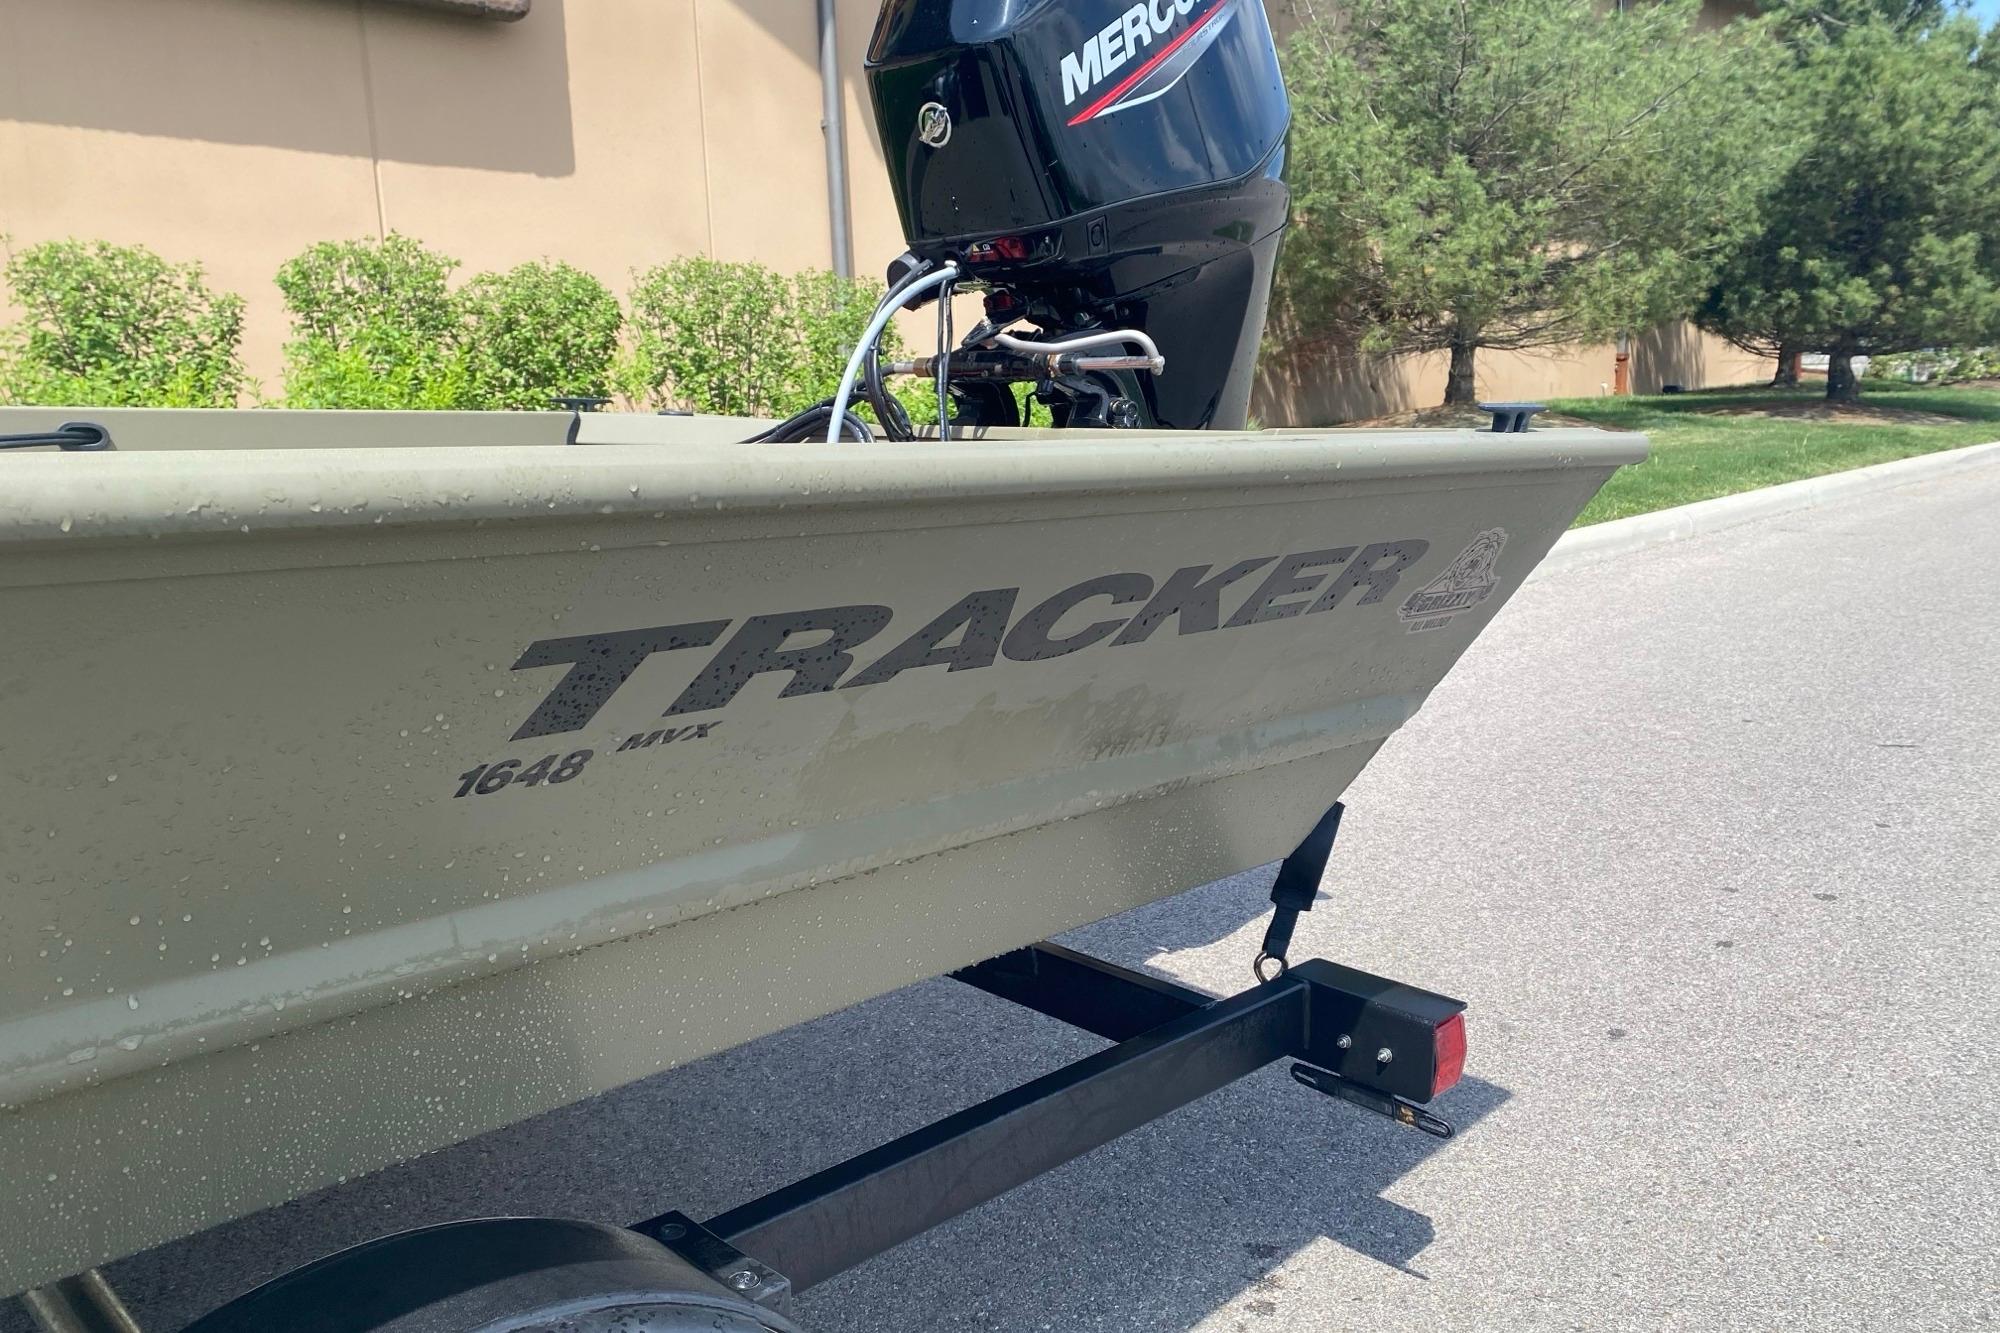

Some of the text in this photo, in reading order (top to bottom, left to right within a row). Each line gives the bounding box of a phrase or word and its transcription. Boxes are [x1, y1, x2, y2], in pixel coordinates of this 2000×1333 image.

[1060, 0, 1200, 106] MERC
[509, 539, 1430, 742] TRACKER
[453, 720, 723, 799] 1648 MVX
